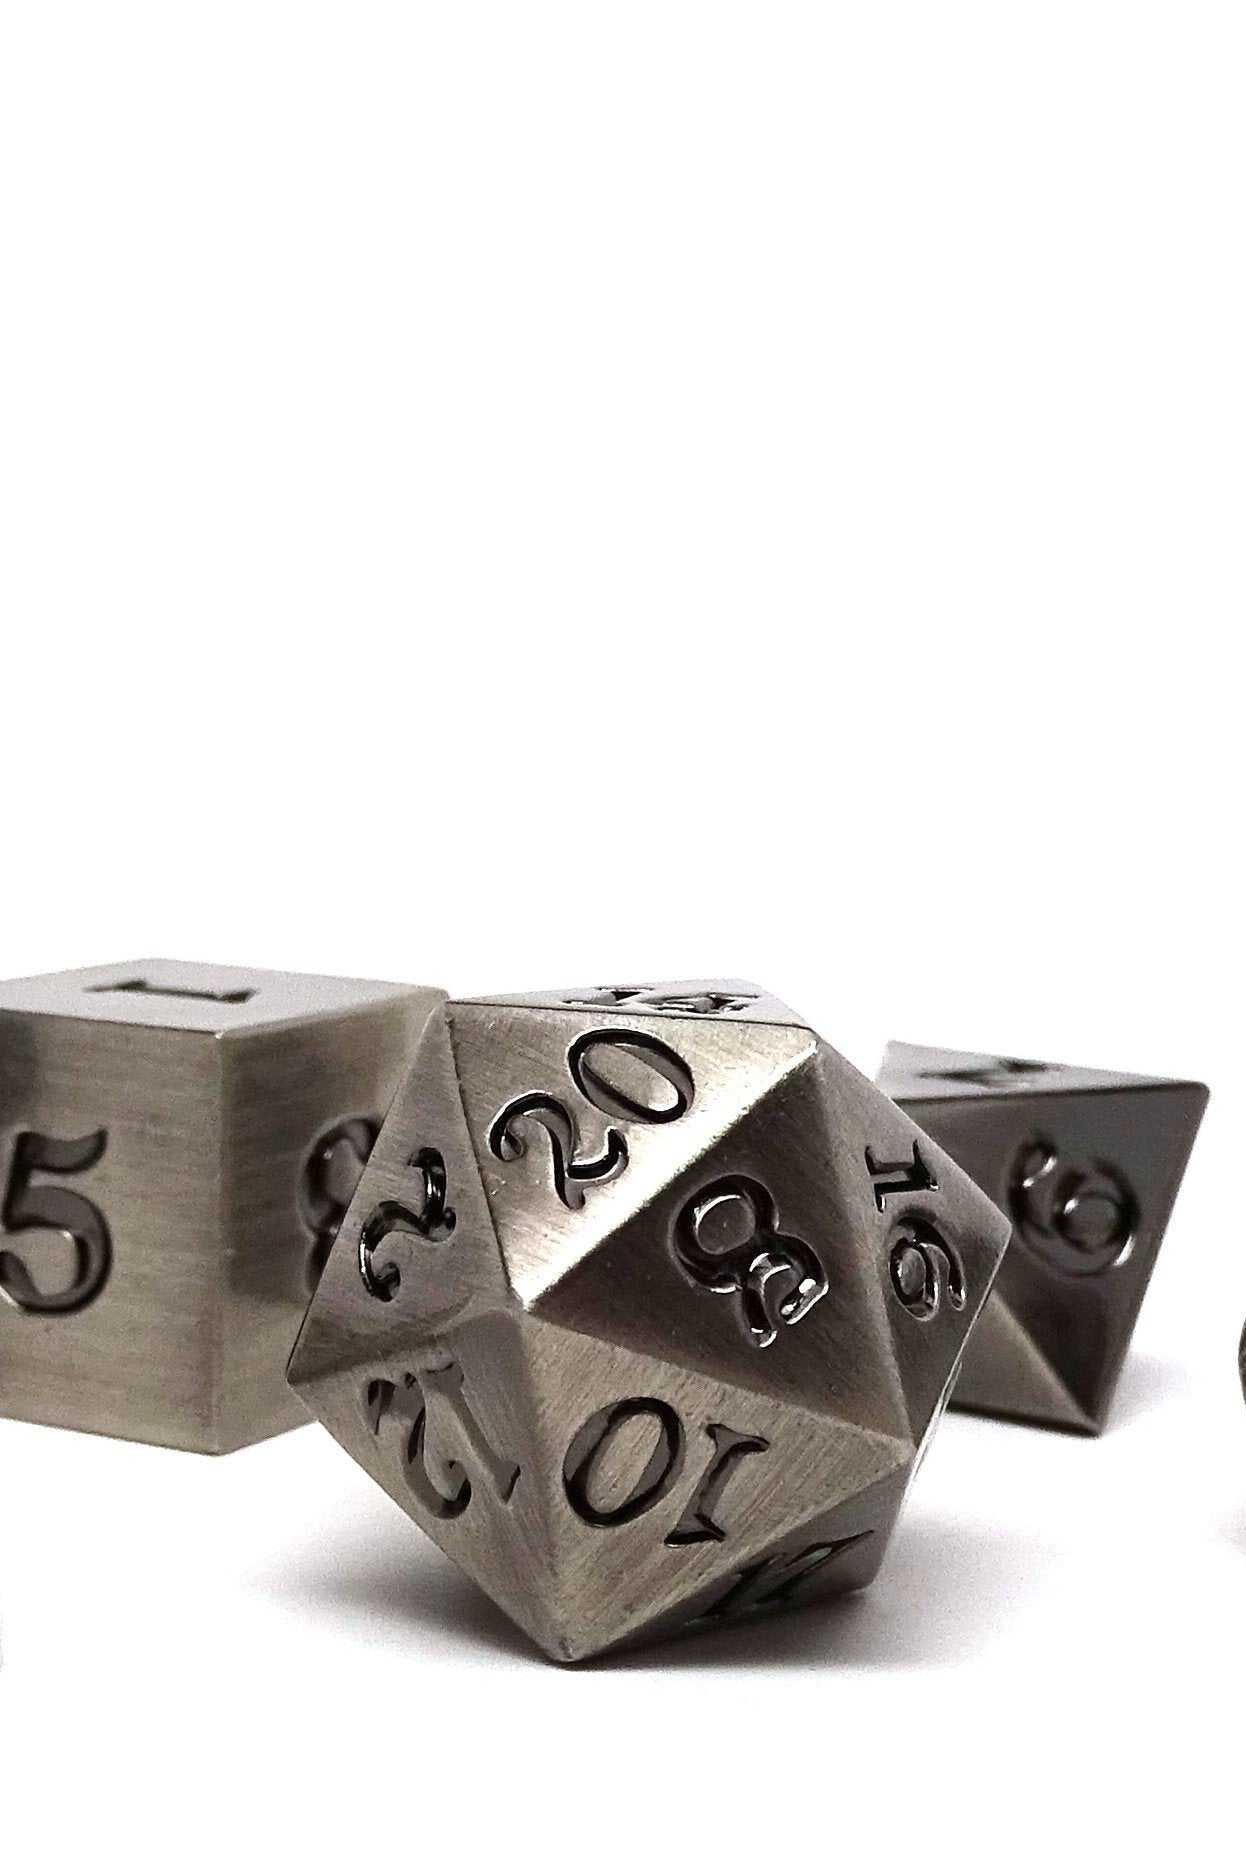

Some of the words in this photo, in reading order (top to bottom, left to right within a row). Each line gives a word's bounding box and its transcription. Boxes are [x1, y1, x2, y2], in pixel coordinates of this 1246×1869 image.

[84, 979, 258, 1003] 1
[487, 1027, 696, 1210] 20
[0, 1128, 112, 1315] 5
[359, 1147, 457, 1302] 2
[669, 1174, 829, 1347] 8
[864, 1138, 967, 1322] 16
[563, 1396, 769, 1549] 10
